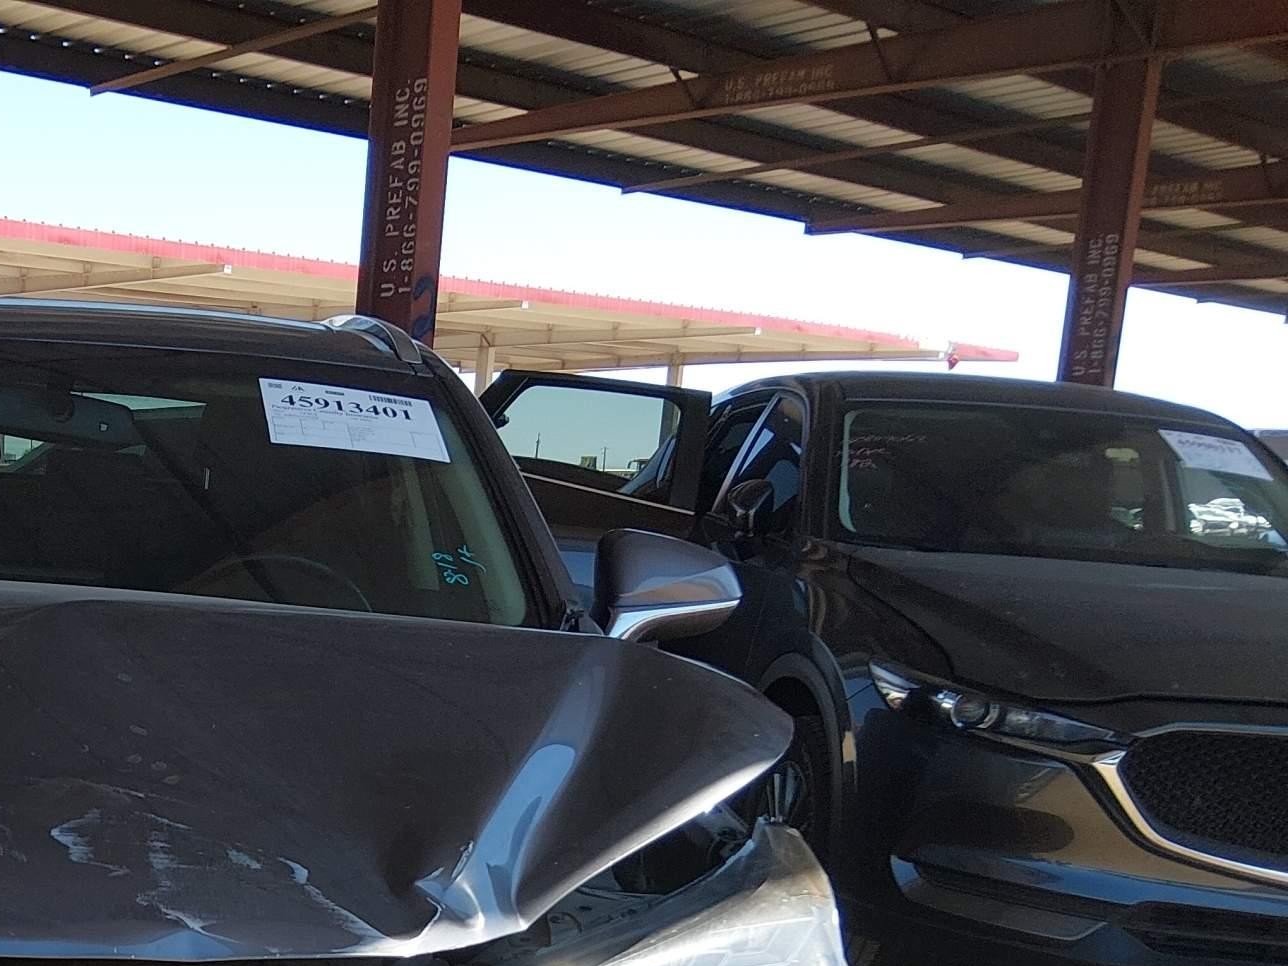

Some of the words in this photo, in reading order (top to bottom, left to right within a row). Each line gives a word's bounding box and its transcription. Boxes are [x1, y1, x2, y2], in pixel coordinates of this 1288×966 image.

[394, 79, 411, 127] INC.
[385, 140, 407, 238] PREFAB
[398, 77, 428, 294] 1-866-799-0969
[1080, 272, 1098, 336] PREFAB
[281, 394, 413, 421] 45913401
